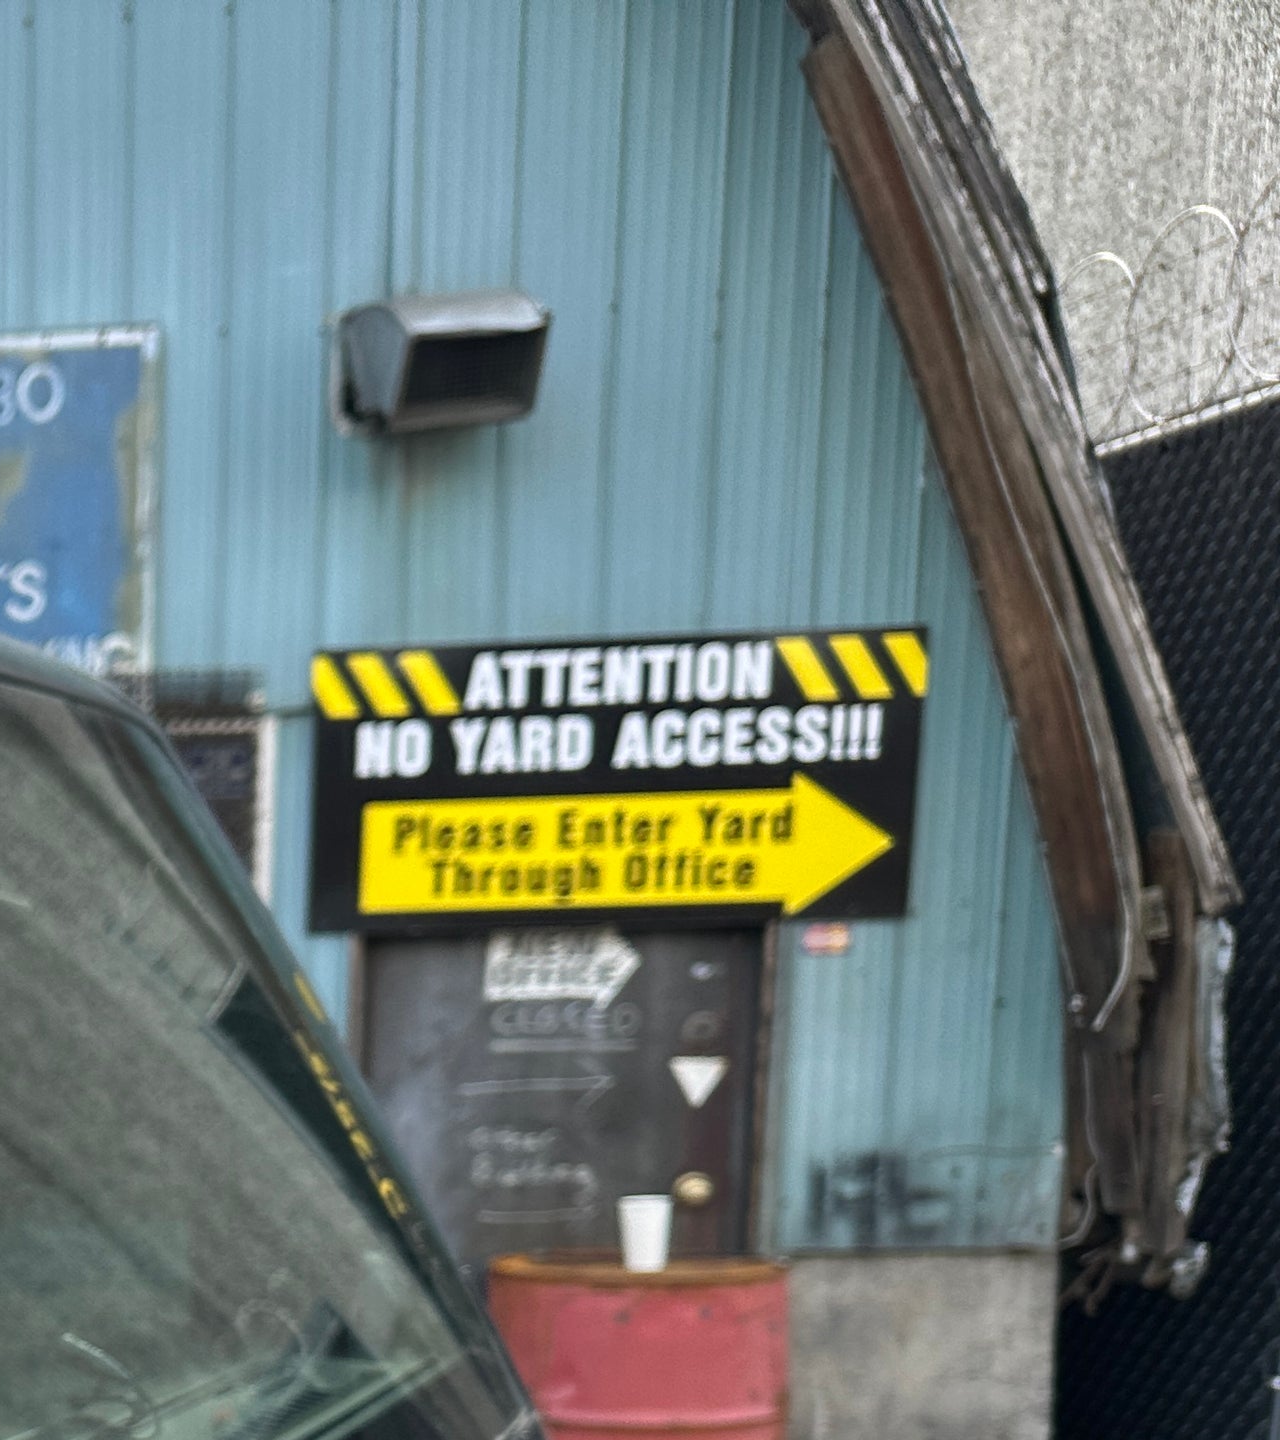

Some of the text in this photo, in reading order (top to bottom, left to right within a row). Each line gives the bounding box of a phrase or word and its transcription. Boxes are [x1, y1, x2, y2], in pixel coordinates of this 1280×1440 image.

[463, 640, 775, 711] ATTENTION
[353, 702, 886, 780] NO YARD ACCESS!!!
[391, 801, 796, 855] Please Enter Yard
[429, 852, 756, 898] Through Office
